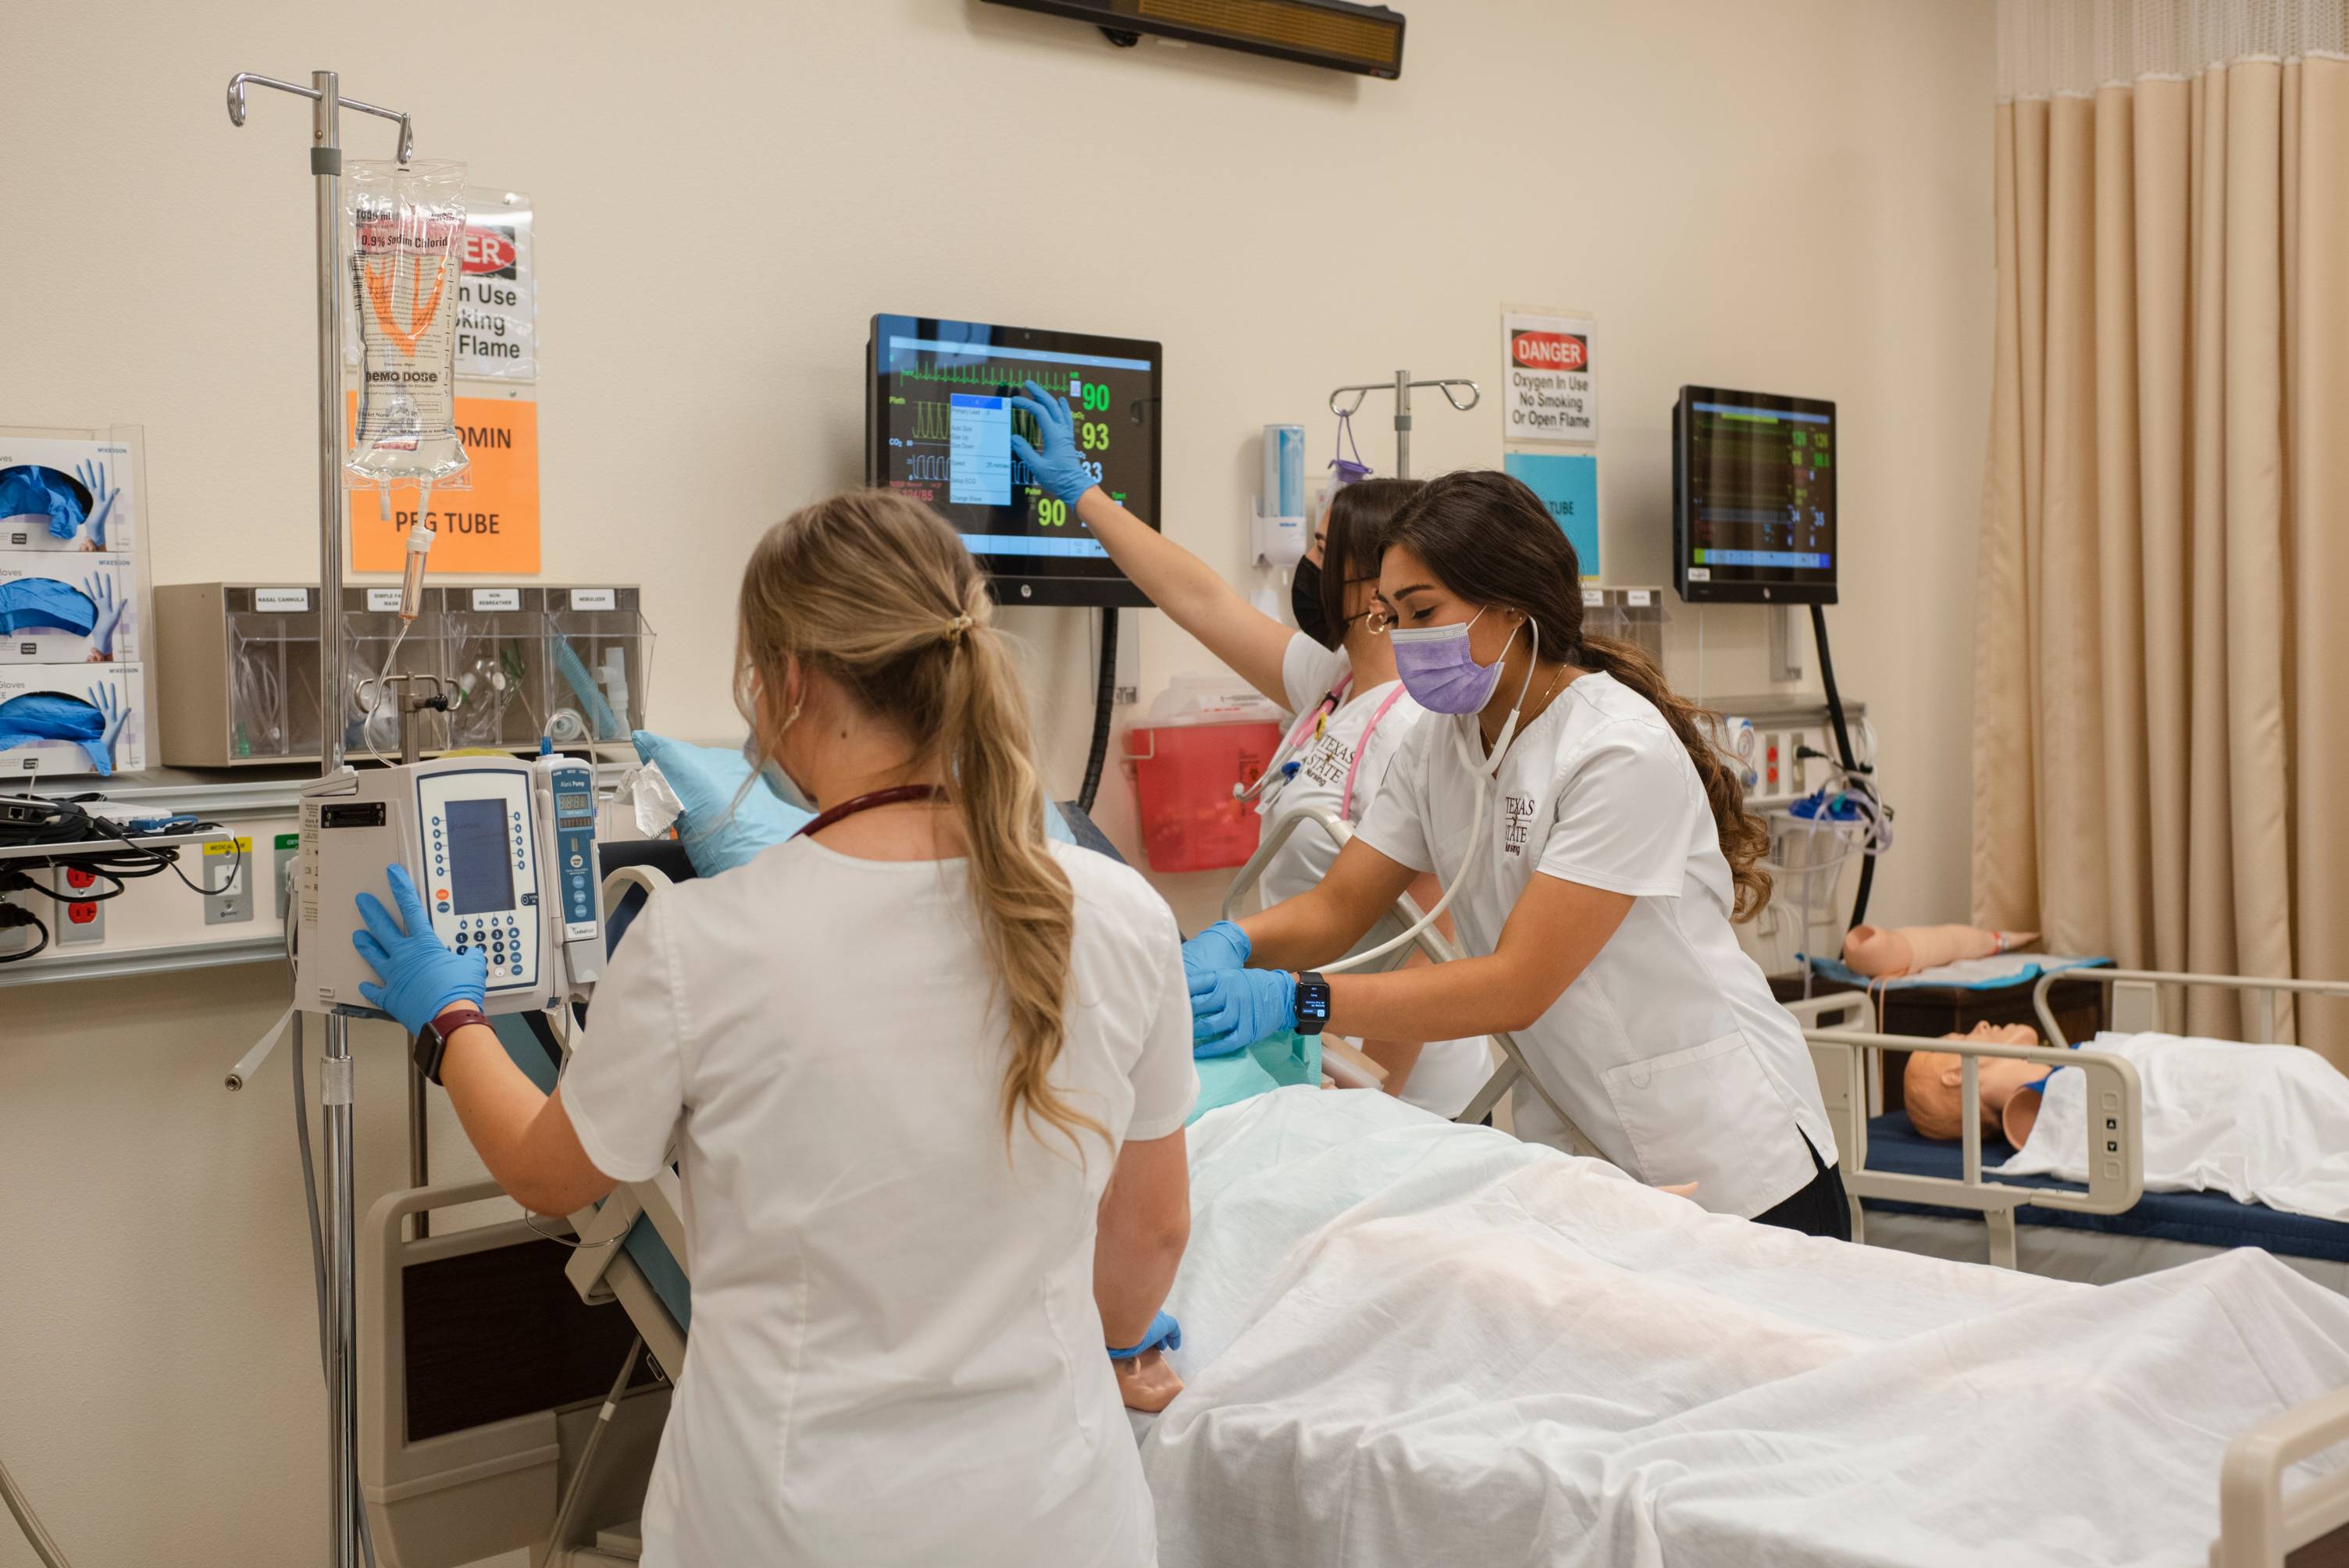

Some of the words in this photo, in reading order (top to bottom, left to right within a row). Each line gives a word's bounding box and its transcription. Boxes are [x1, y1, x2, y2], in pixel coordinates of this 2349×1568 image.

[362, 235, 385, 248] 0.9%
[479, 284, 517, 306] Use
[456, 308, 505, 337] king
[459, 334, 520, 358] Flame
[1518, 340, 1582, 364] DANGER
[1513, 372, 1554, 391] Oxygen
[1556, 375, 1566, 390] In
[1569, 376, 1589, 391] Use
[1082, 383, 1110, 412] 90
[1520, 392, 1535, 407] No
[1538, 392, 1583, 413] Smoking
[1513, 409, 1525, 424] Or
[1528, 411, 1557, 427] Open
[1559, 412, 1590, 429] Flame
[1082, 422, 1110, 451] 93
[1038, 498, 1066, 526] 90
[1549, 501, 1574, 515] TUBE
[444, 512, 500, 534] TUBE
[1321, 734, 1356, 764] TEXAS
[1307, 754, 1343, 783] STATE
[1505, 796, 1535, 816] TEXAS
[1505, 825, 1527, 843] TATE
